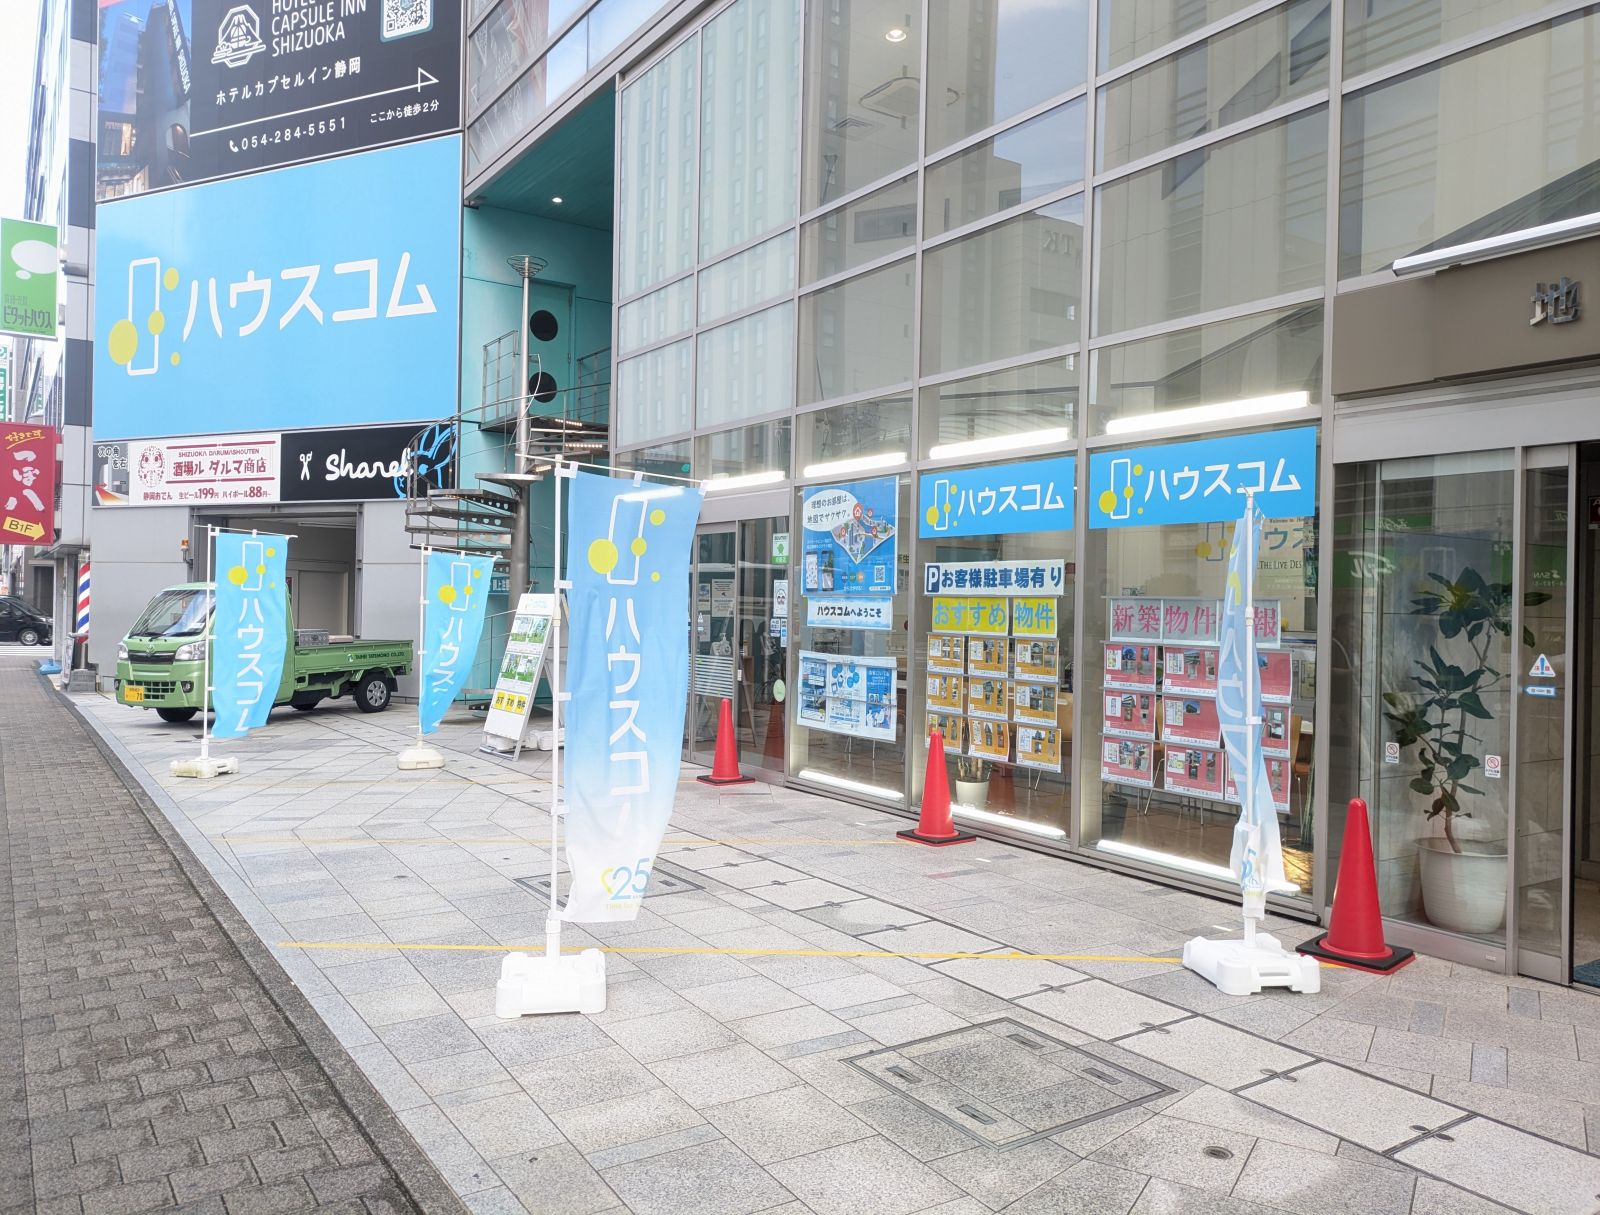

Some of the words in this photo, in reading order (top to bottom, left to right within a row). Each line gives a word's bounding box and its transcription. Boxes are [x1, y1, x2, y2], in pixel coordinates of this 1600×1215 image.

[272, 2, 335, 35] CAPSULE
[341, 0, 366, 17] INN
[272, 21, 345, 57] SHIZUOKA
[216, 56, 361, 105] ホテルカプセルイン静岡
[370, 99, 439, 123] ここから徒歩2分
[242, 117, 345, 150] 054-284-5551
[183, 251, 438, 341] ハウスコム
[1529, 276, 1579, 325] 地
[5, 450, 45, 511] つぼ八
[1144, 458, 1302, 503] ハウスコム
[957, 481, 1065, 517] ハウスコム
[9, 519, 34, 533] B1F
[941, 567, 1062, 588] お客様駐車場有り
[817, 604, 882, 619] ハウスコムへようこそ
[1112, 604, 1278, 638] 新築物件報
[606, 597, 650, 837] ハウスコ
[612, 857, 651, 899] 25
